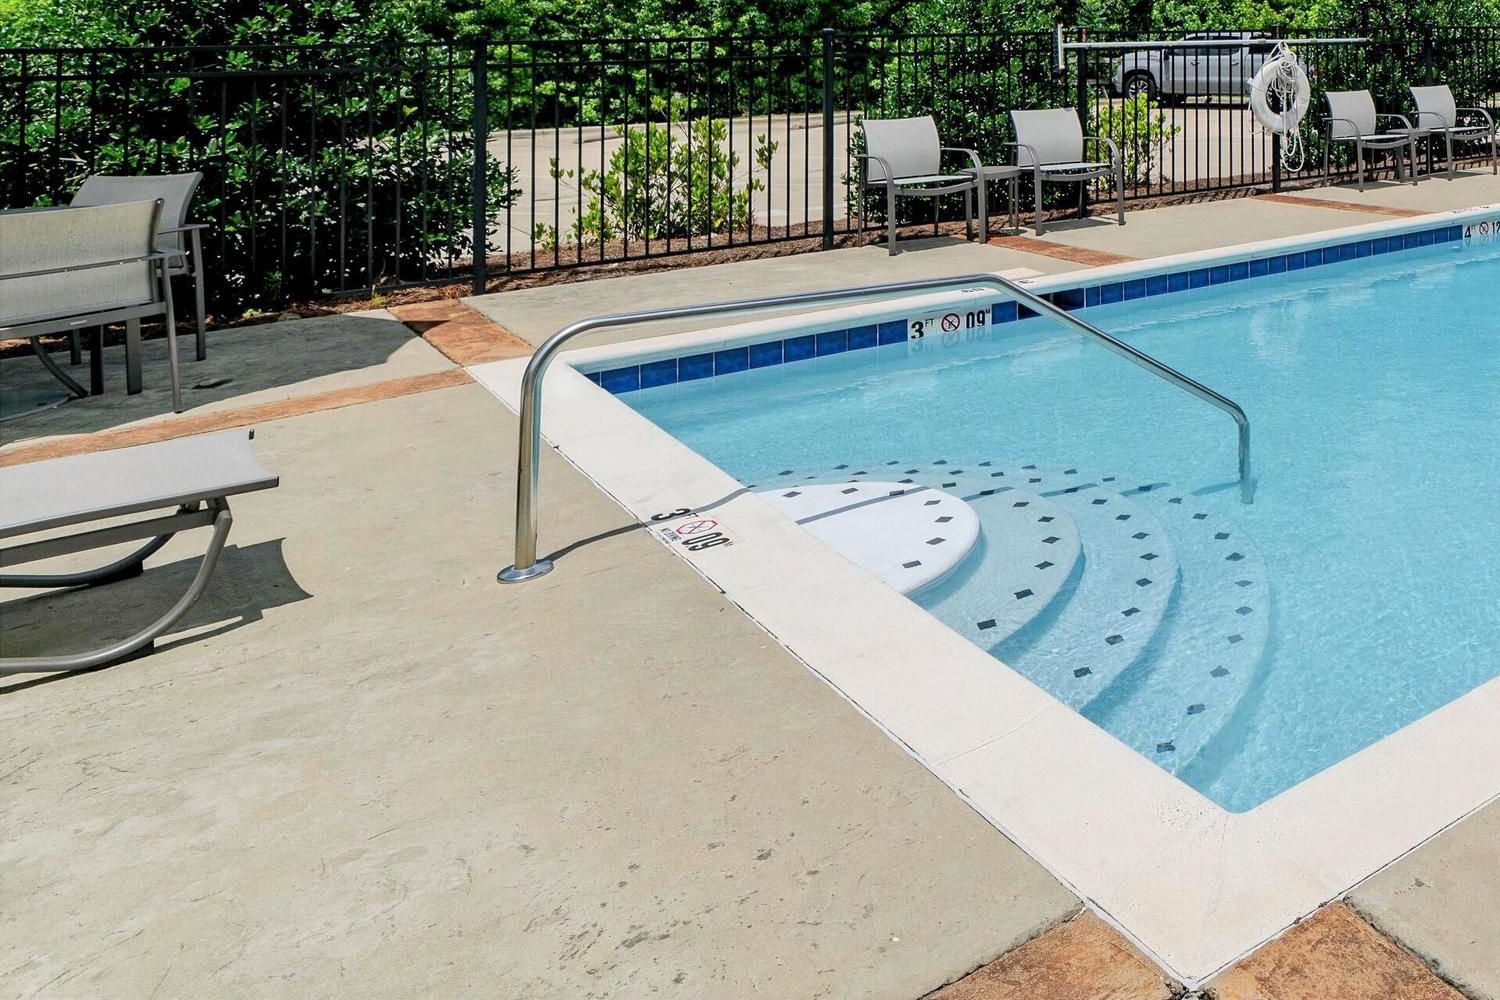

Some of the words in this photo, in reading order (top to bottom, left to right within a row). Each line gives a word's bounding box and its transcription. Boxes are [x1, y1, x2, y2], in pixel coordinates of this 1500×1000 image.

[1464, 225, 1471, 238] 4
[911, 321, 924, 339] 3
[650, 508, 691, 521] 3
